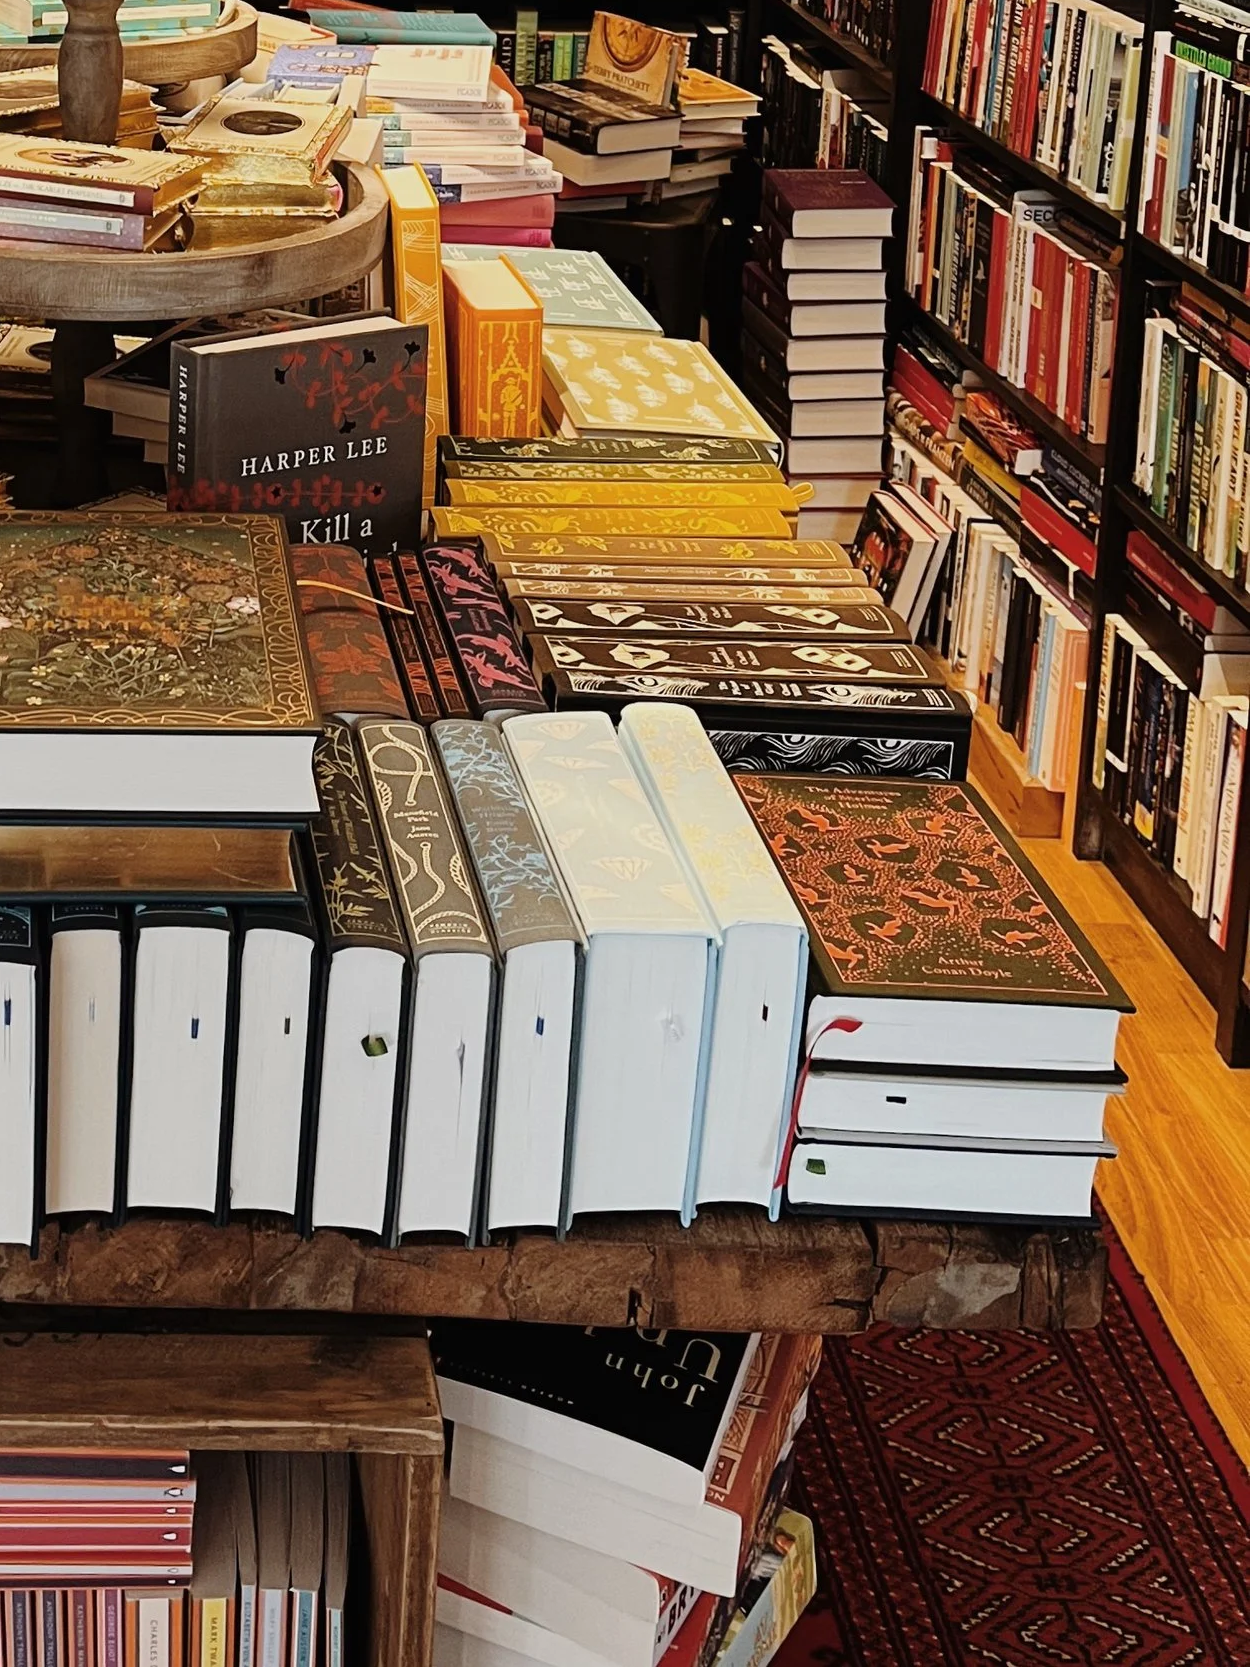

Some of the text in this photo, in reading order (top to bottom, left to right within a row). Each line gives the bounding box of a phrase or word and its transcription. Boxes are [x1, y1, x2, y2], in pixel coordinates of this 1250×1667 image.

[177, 364, 188, 474] HARPER LEE
[240, 436, 389, 477] HARPER LEE
[300, 512, 373, 545] Kill a
[804, 785, 831, 794] The
[921, 965, 1014, 979] Conan Doyle
[937, 956, 984, 967] Arthur
[604, 1352, 706, 1408] John
[150, 1619, 158, 1663] CHARLES
[210, 1616, 218, 1646] MARK
